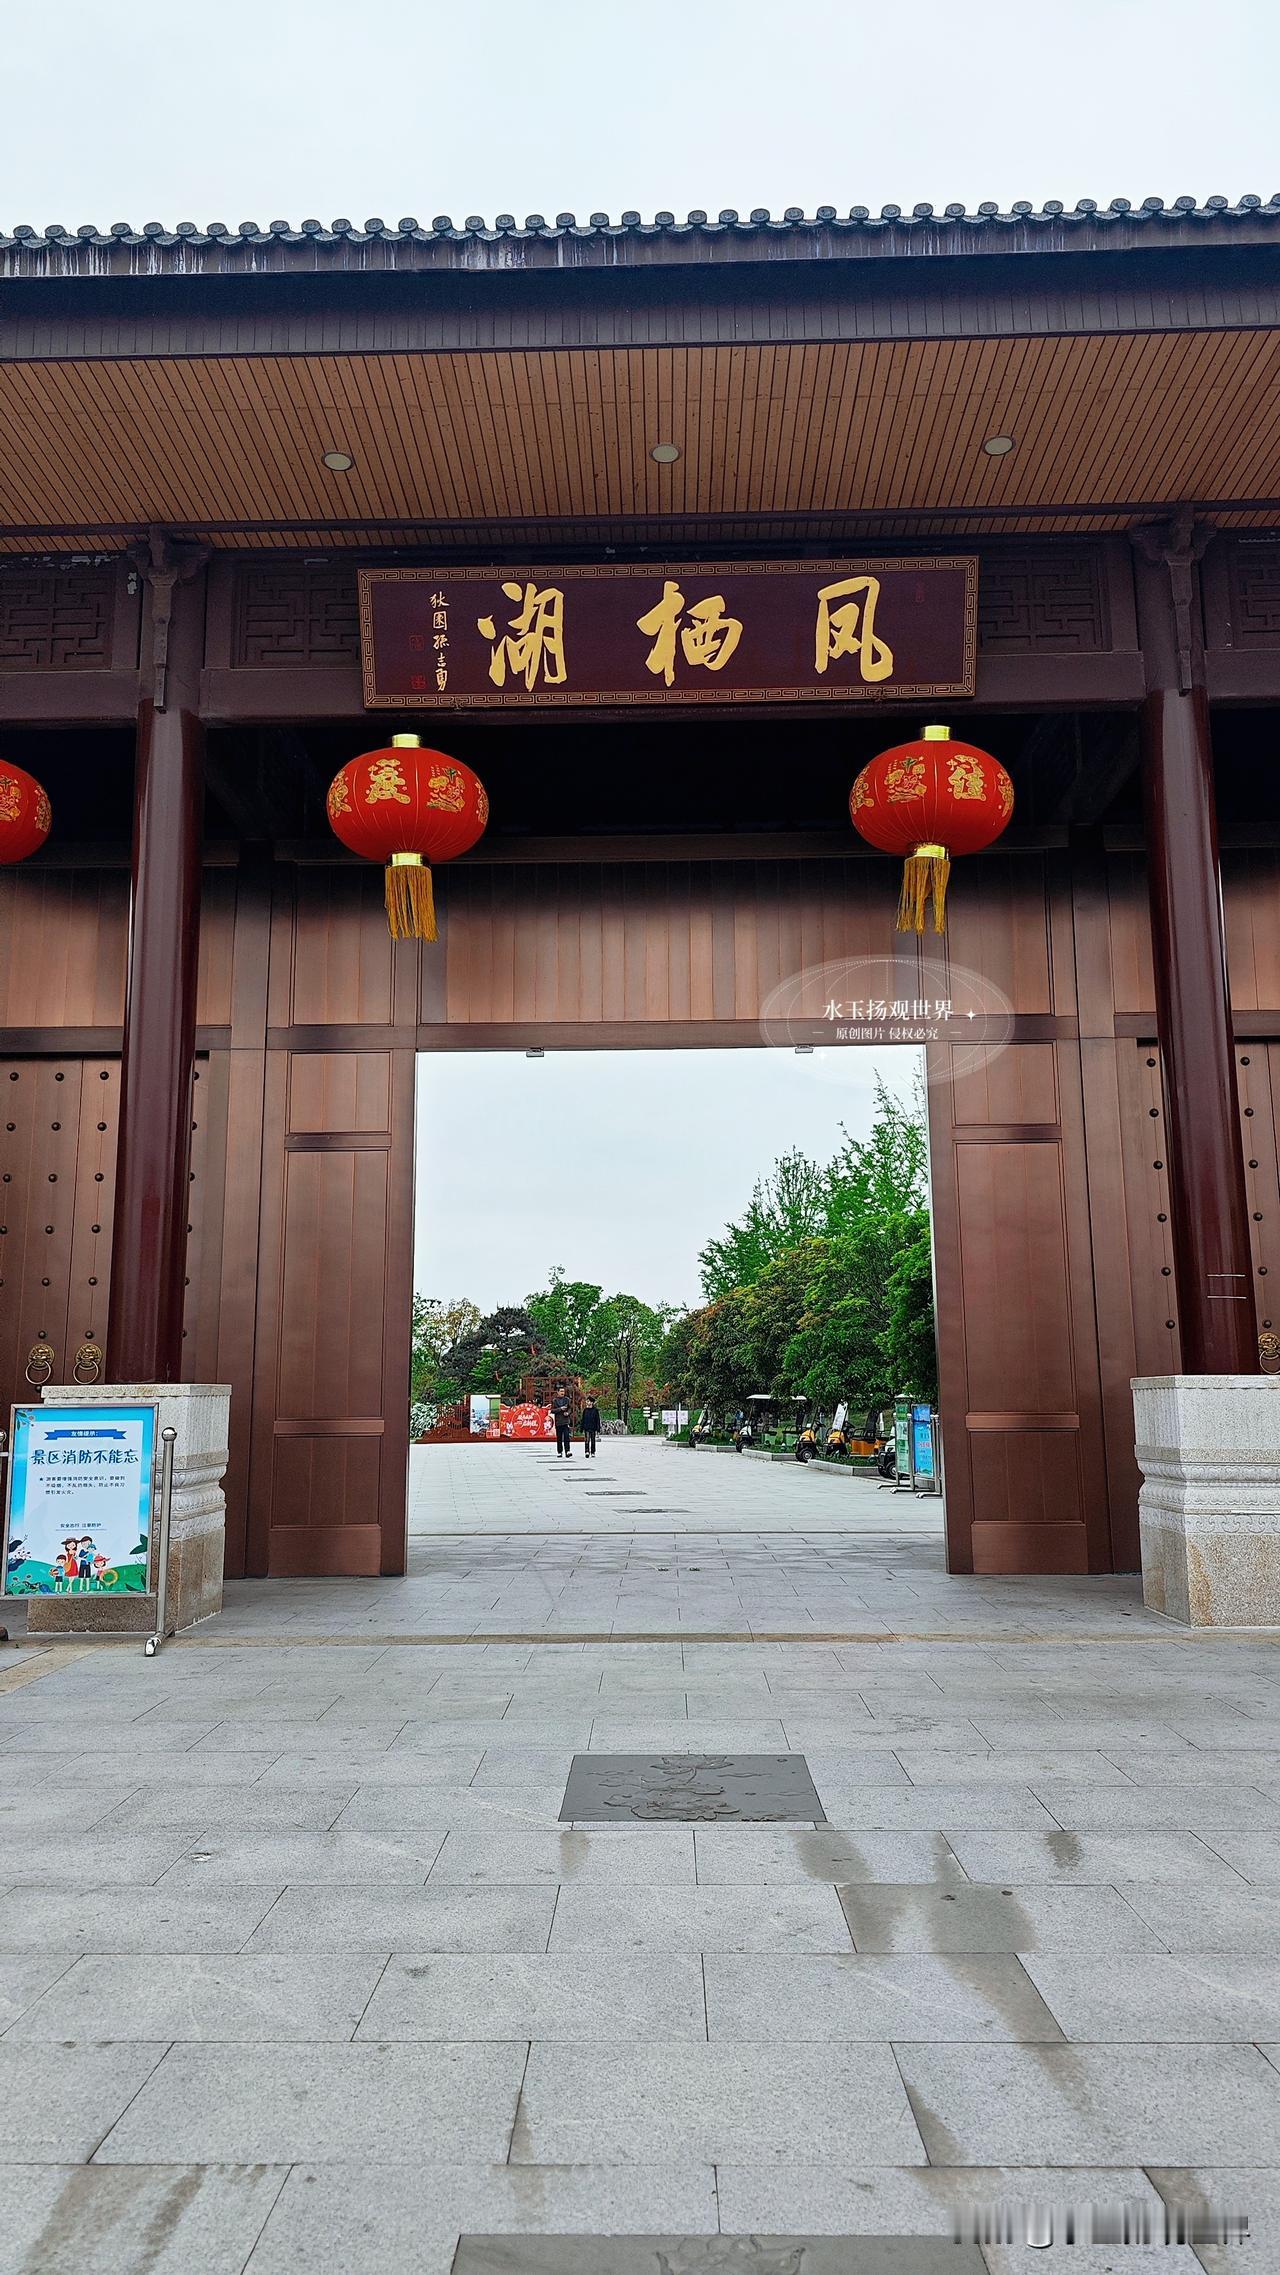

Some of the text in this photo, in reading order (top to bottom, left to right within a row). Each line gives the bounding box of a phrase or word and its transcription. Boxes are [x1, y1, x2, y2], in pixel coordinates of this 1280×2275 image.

[31, 1449, 138, 1465] 景区消防不能忘
